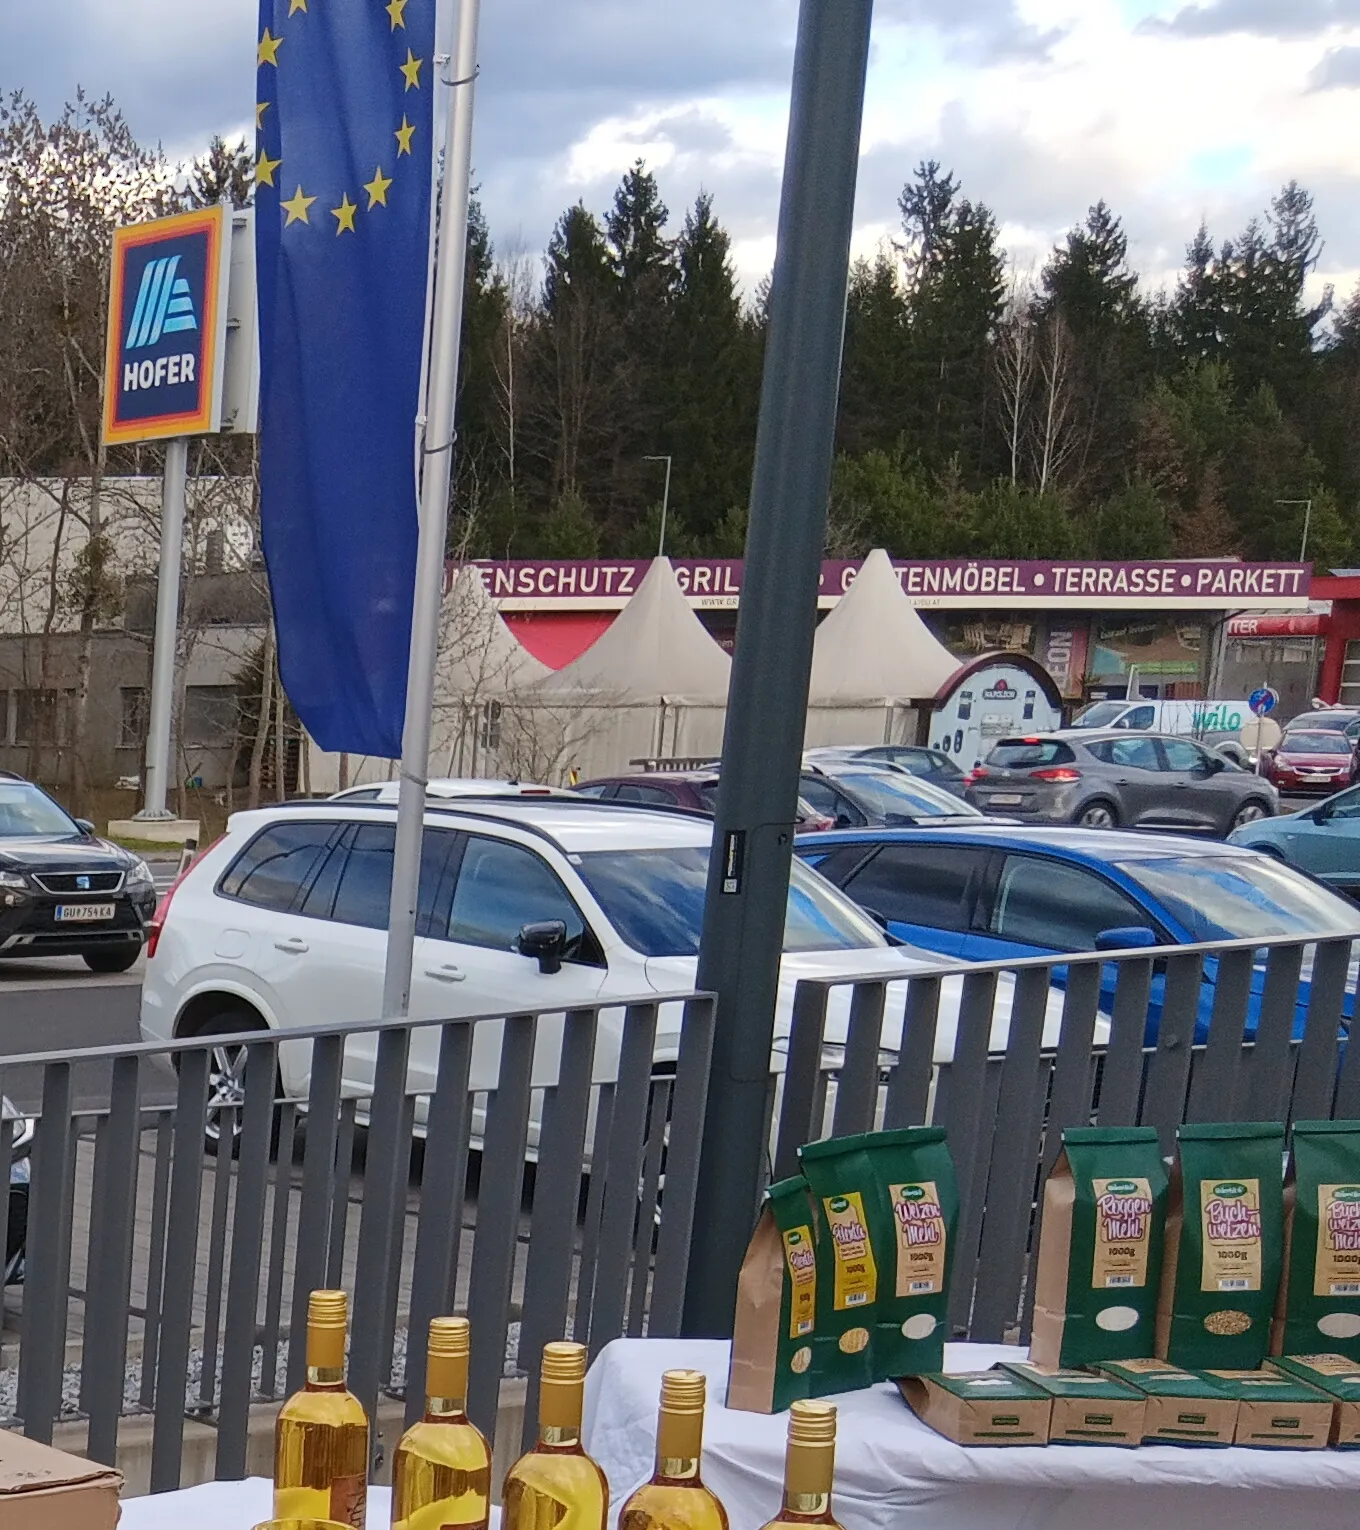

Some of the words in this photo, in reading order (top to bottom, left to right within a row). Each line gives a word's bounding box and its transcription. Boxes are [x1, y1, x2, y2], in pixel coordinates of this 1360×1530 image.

[123, 353, 195, 391] HOFER
[443, 566, 635, 594] ENSCHUTZ
[841, 562, 1026, 592] GTENMÖBEL
[1052, 568, 1176, 592] TERRASSE
[1197, 569, 1304, 593] PARKETT
[1194, 704, 1241, 731] wilo
[894, 1201, 942, 1223] Weizen
[1097, 1194, 1152, 1219] Roggen
[902, 1221, 939, 1246] Mehl
[1104, 1218, 1142, 1240] Mehl
[1207, 1221, 1261, 1240] weizen
